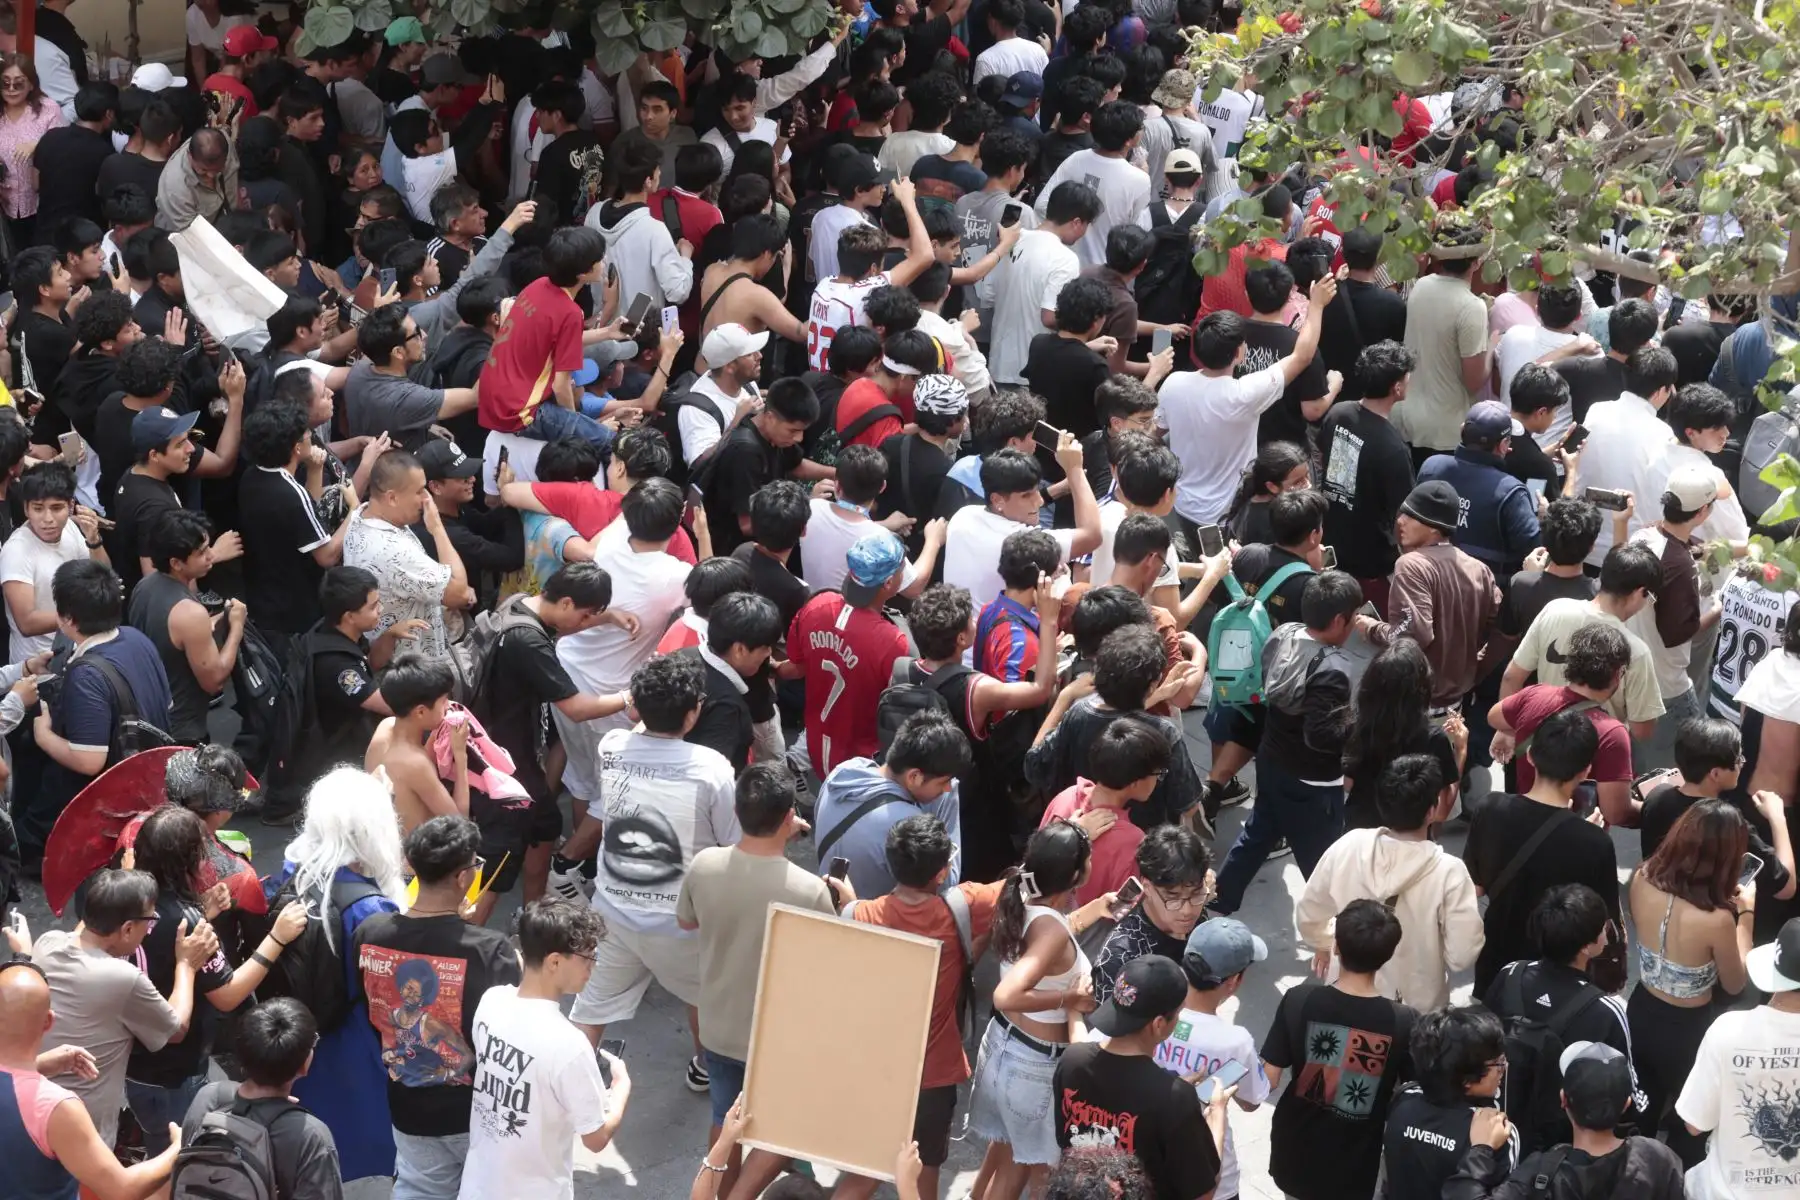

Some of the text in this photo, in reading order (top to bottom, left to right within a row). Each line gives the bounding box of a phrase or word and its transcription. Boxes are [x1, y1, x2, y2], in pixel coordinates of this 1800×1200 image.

[1198, 101, 1231, 122] RONALDO
[1335, 424, 1349, 436] LEO
[1753, 595, 1780, 610] SANTO
[1724, 599, 1772, 629] C. RONALDO
[809, 630, 859, 670] RONALDO
[1716, 618, 1769, 687] 28
[820, 658, 846, 723] 7
[622, 763, 660, 781] START
[634, 891, 651, 900] TO
[653, 893, 679, 902] THE
[436, 962, 460, 972] ALLEN
[1773, 1047, 1791, 1056] THE
[1732, 1054, 1756, 1069] OF
[1403, 1125, 1457, 1151] JUVENTUS
